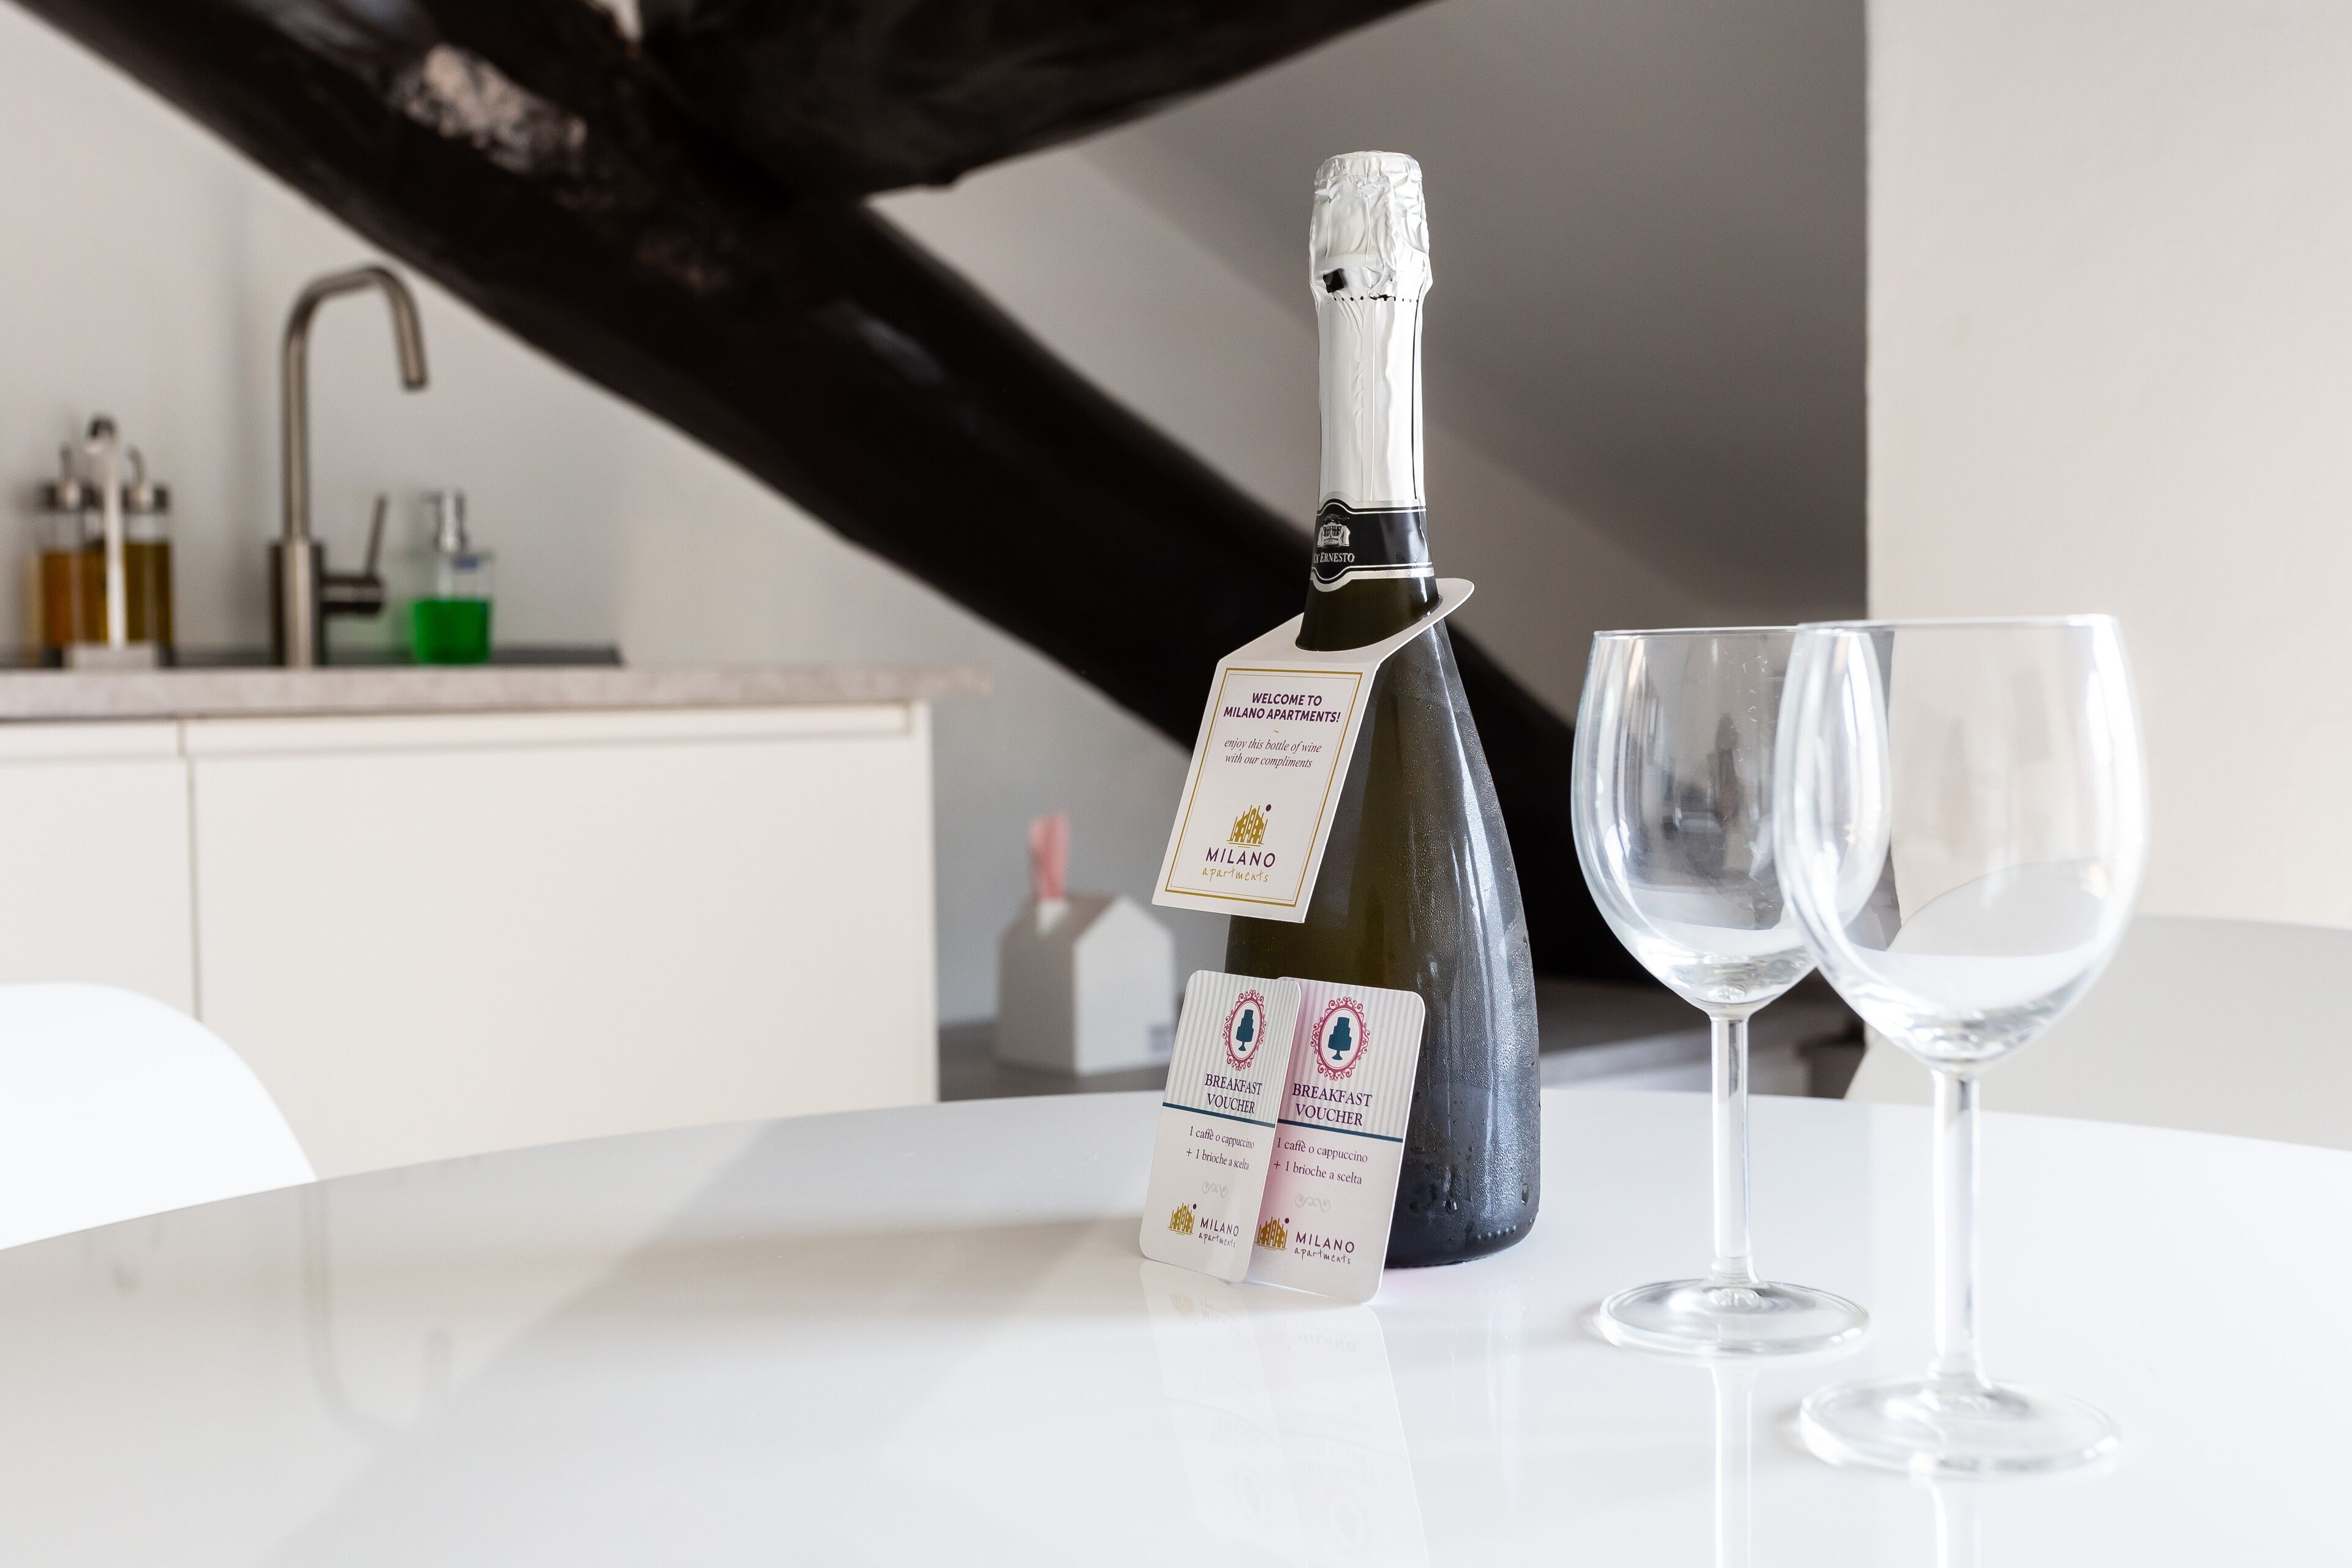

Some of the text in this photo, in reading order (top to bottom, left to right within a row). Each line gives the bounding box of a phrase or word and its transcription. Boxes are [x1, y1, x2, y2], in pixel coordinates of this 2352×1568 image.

[1320, 552, 1355, 563] ERNESTO
[1252, 693, 1322, 706] WELCOME TO
[1223, 706, 1341, 723] MILANO APARTMENTS!
[1224, 738, 1322, 754] enjoy this bottle of wine
[1225, 753, 1313, 769] with our compliments
[1205, 846, 1276, 868] MILANO
[1202, 866, 1269, 883] apartments
[1204, 1073, 1263, 1096] BREAKFAST
[1292, 1083, 1373, 1107] BREAKFAST
[1207, 1093, 1255, 1114] VOUCHER
[1295, 1103, 1363, 1126] VOUCHER
[1189, 1126, 1194, 1136] 1
[1196, 1128, 1214, 1140] caffè
[1221, 1136, 1254, 1150] cappuccino
[1186, 1148, 1193, 1157] +
[1196, 1149, 1200, 1159] 1
[1202, 1149, 1227, 1165] brioche
[1234, 1158, 1250, 1170] scelta
[1277, 1137, 1281, 1148] 1
[1284, 1140, 1306, 1152] caffè
[1317, 1147, 1368, 1163] cappuccino
[1273, 1160, 1281, 1169] +
[1285, 1161, 1289, 1171] 1
[1293, 1161, 1327, 1178] brioche
[1336, 1172, 1362, 1185] scelta
[1200, 1216, 1239, 1237] MILANO
[1199, 1232, 1236, 1248] apartments
[1295, 1231, 1354, 1253] MILANO
[1294, 1247, 1351, 1264] apartments
